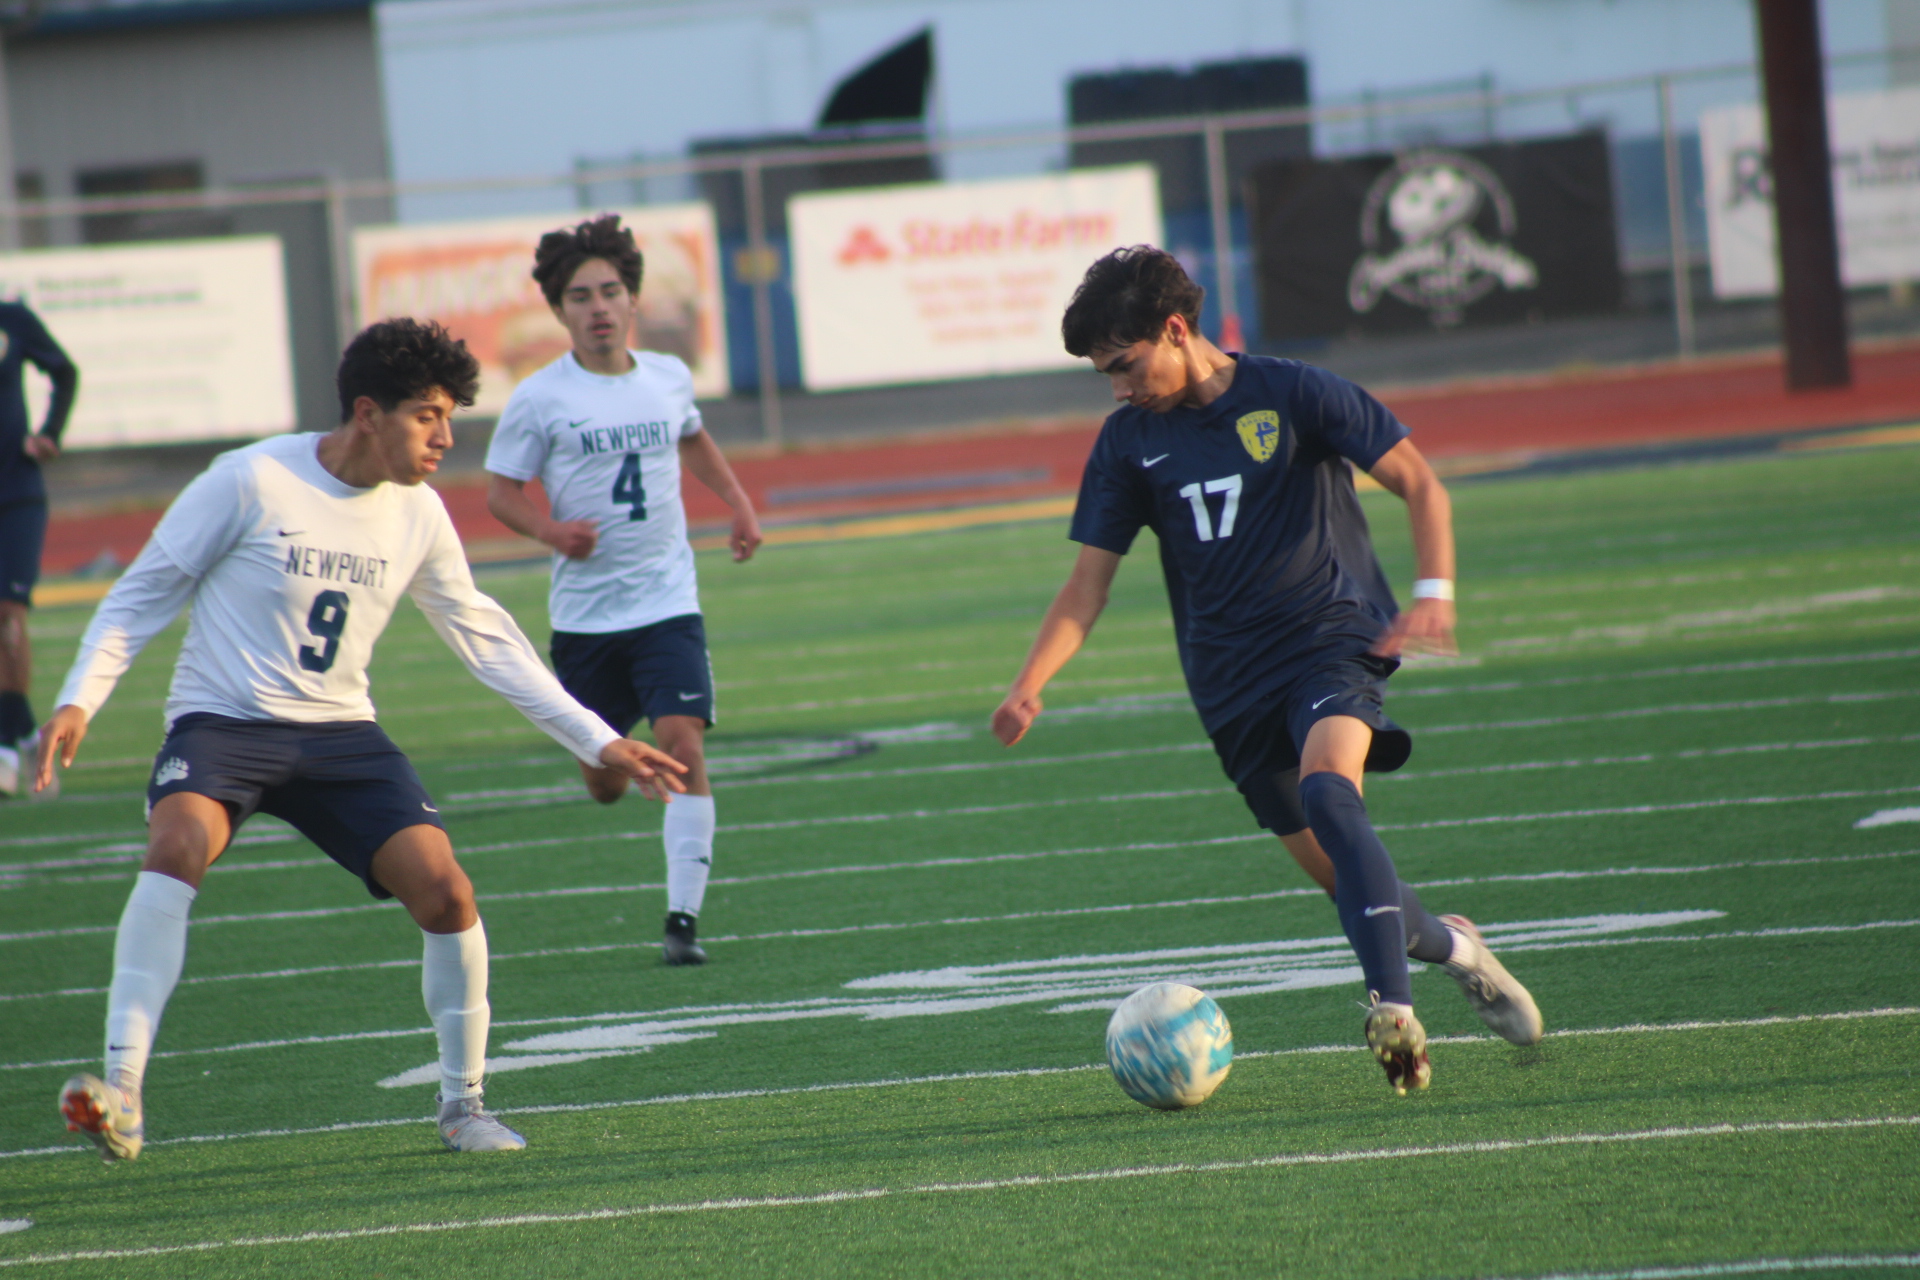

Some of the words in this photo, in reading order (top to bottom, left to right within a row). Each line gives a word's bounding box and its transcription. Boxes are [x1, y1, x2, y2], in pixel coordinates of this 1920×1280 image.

[902, 217, 1004, 262] State
[1009, 209, 1114, 254] Farm
[378, 252, 531, 320] HUNGR
[580, 421, 670, 456] NEWPORT
[612, 453, 647, 521] 4
[1179, 473, 1243, 542] 17
[286, 544, 389, 589] NEWPORT
[299, 589, 349, 673] 9
